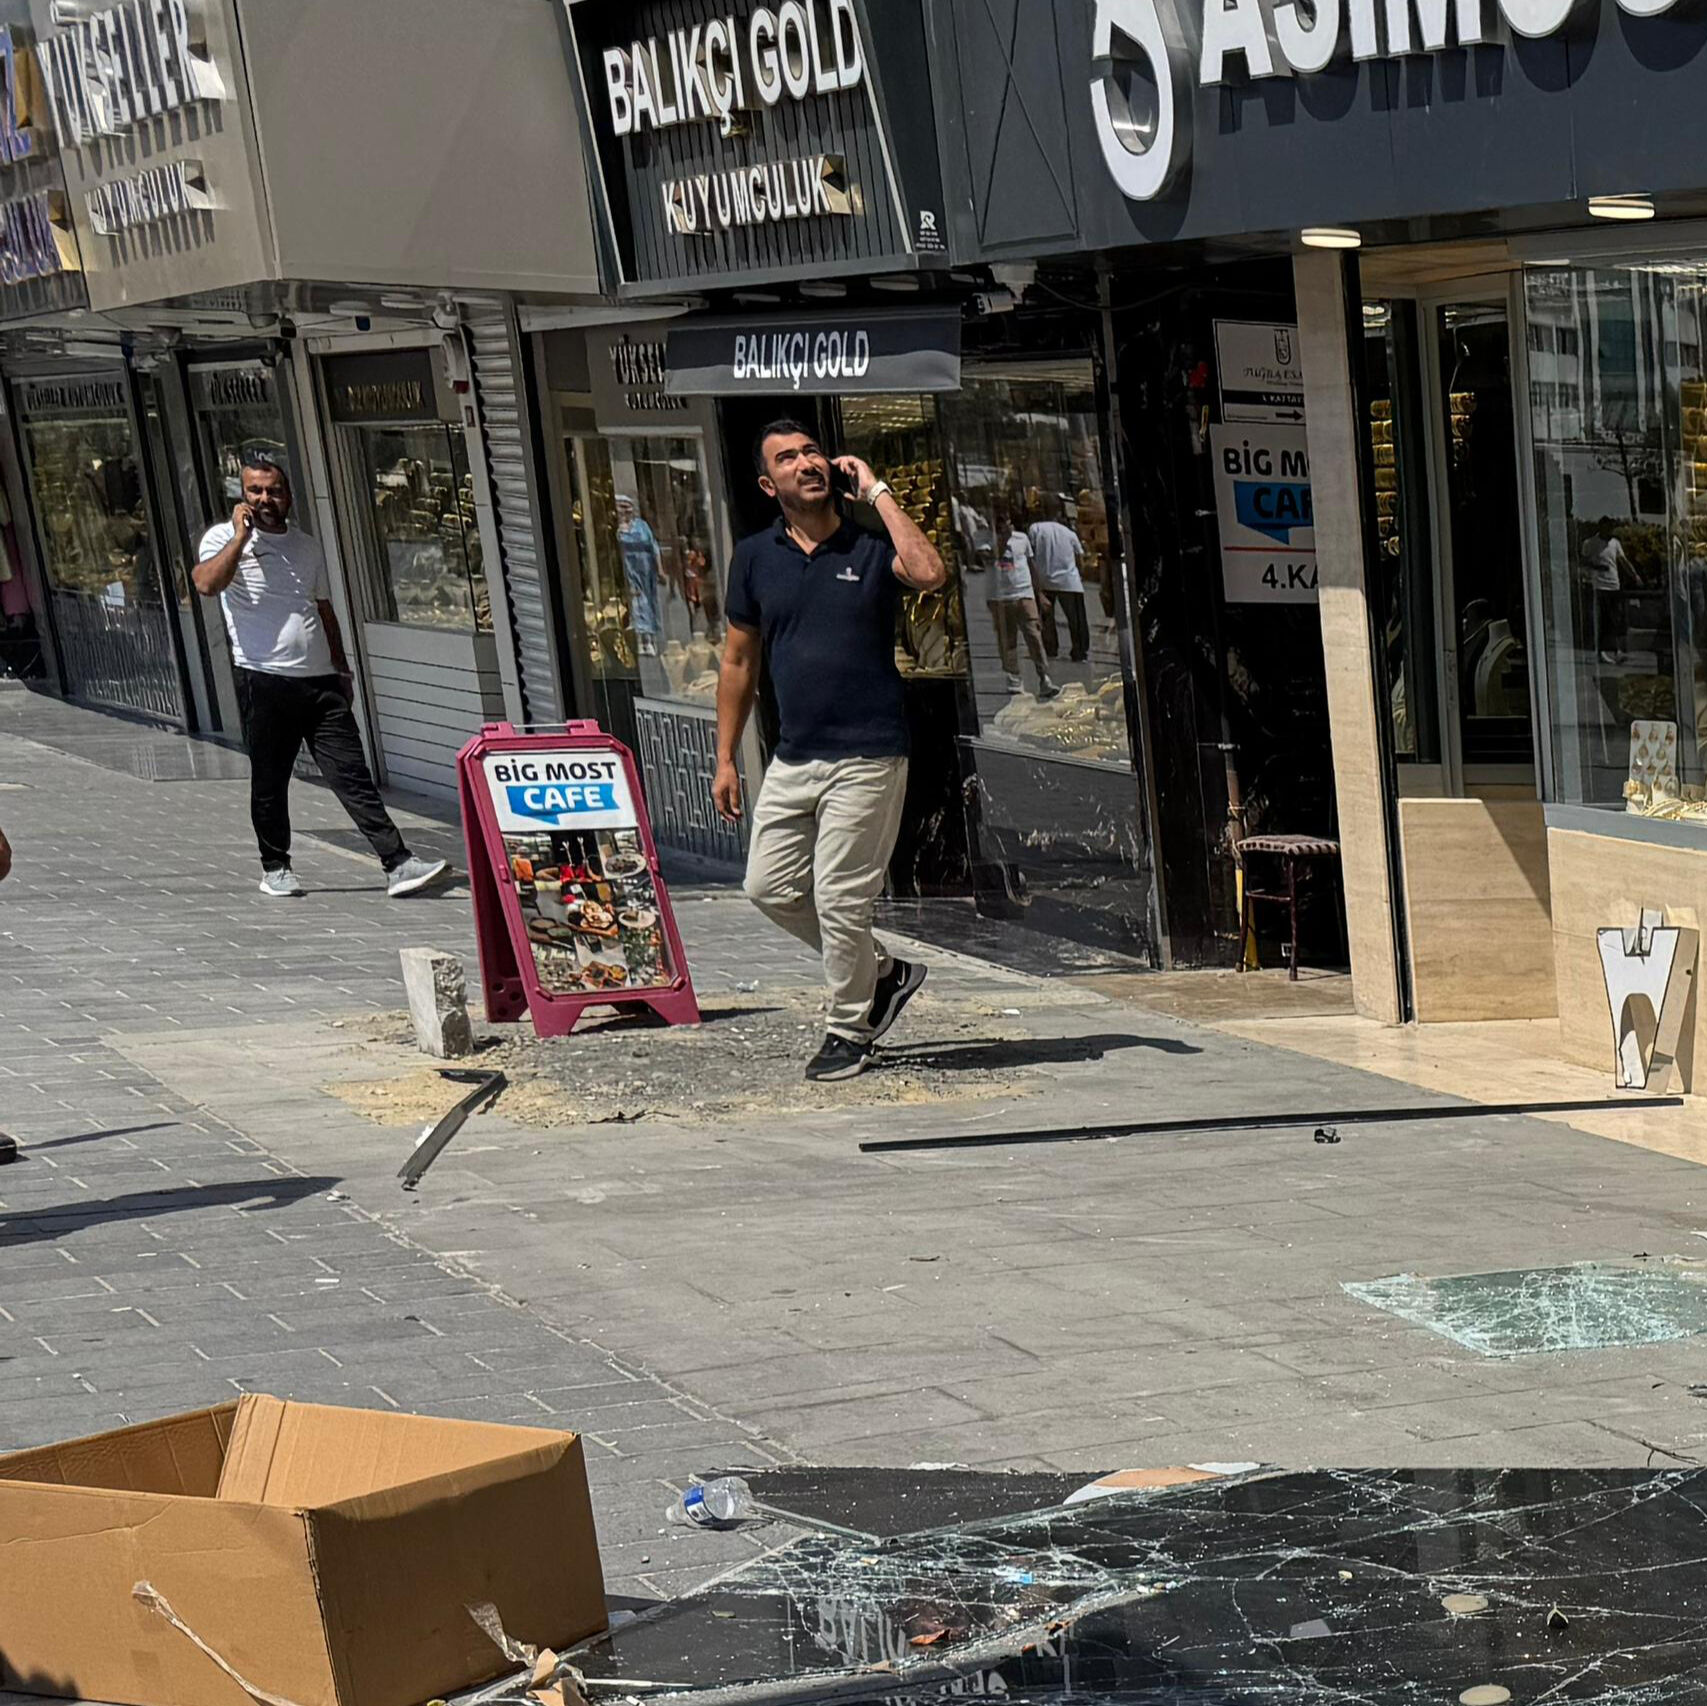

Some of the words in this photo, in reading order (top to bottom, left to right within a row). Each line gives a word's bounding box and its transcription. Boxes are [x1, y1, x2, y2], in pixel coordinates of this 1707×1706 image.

[602, 15, 745, 139] BALIKÇI
[751, 0, 863, 107] GOLD
[662, 157, 831, 236] KUYUMCULUK
[733, 332, 810, 390] BALIKÇI
[813, 330, 870, 379] GOLD
[1223, 440, 1272, 476] BİG
[1280, 450, 1310, 478] M
[494, 759, 538, 782] BİG
[546, 762, 617, 781] MOST
[523, 787, 604, 810] CAFE
